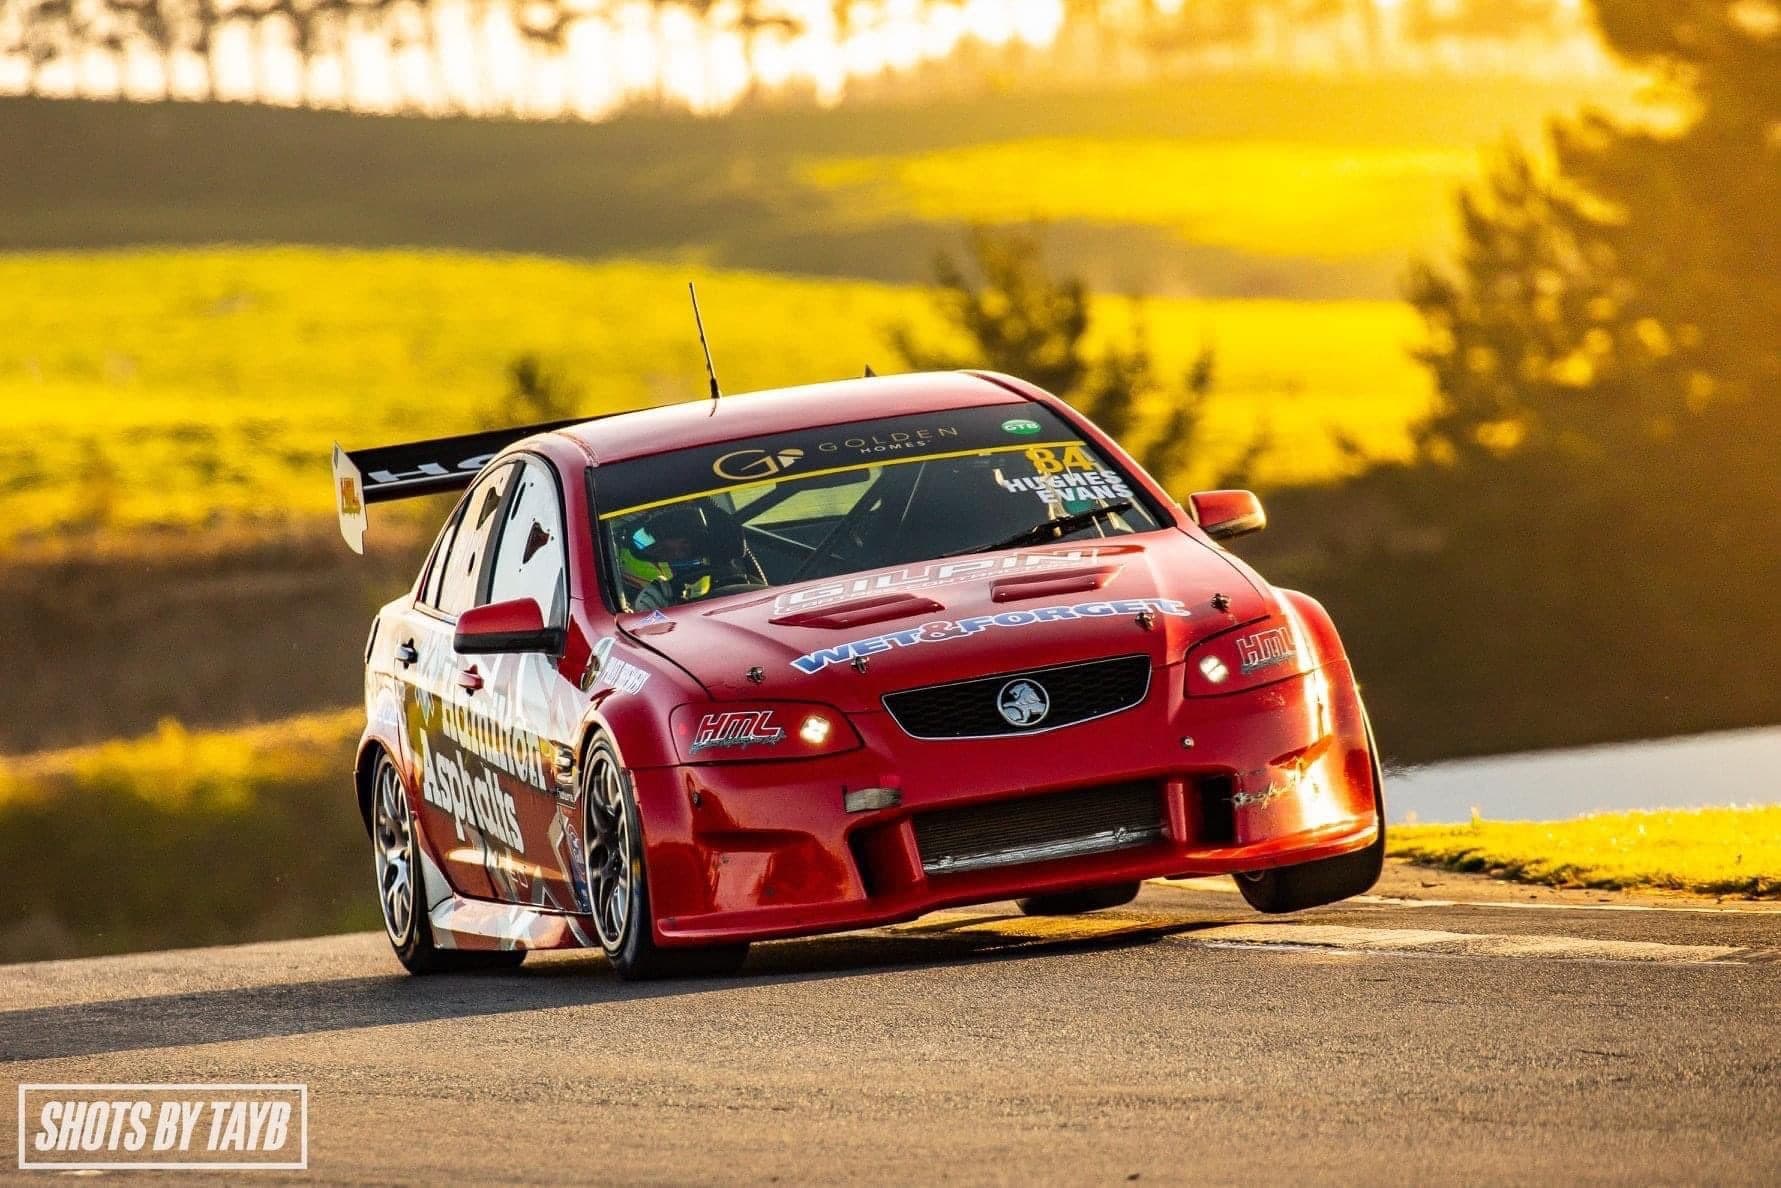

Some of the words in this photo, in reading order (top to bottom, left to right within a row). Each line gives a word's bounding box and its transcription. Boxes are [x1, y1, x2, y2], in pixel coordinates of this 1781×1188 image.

[818, 427, 959, 452] GOLDEN
[860, 441, 927, 454] HOMES
[1026, 447, 1097, 474] 84
[1004, 470, 1123, 493] HUGHES
[1036, 484, 1134, 503] EVANS
[786, 549, 1085, 607] GILPIN
[420, 728, 525, 854] Asphalts
